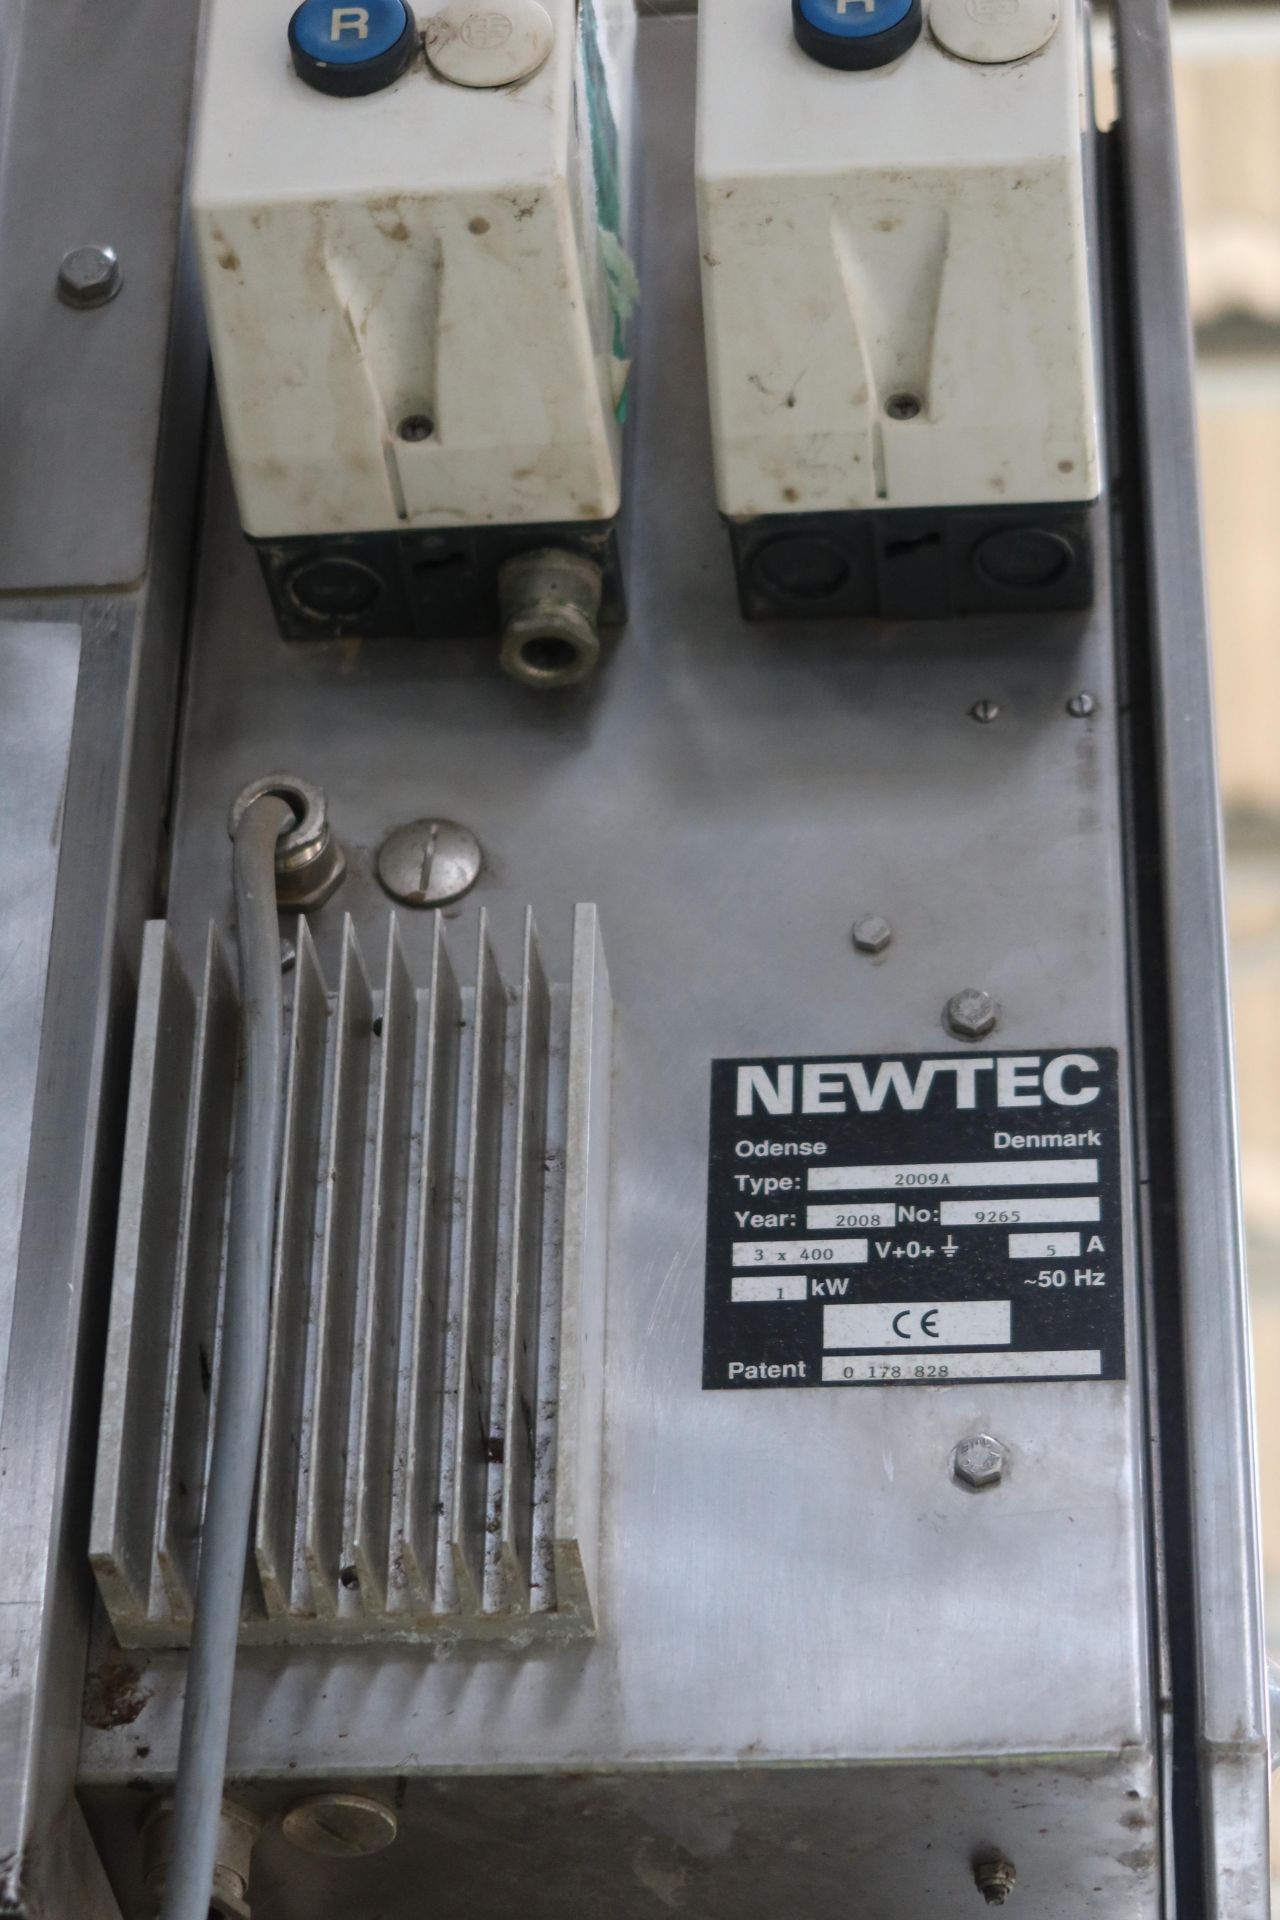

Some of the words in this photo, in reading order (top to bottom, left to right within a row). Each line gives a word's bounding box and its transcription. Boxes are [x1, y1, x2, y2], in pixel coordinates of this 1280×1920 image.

[331, 7, 369, 41] R
[736, 1054, 1100, 1116] NEWTEC
[735, 1139, 828, 1158] Odense
[994, 1129, 1102, 1150] Denmark
[734, 1173, 801, 1195] Type:
[895, 1172, 951, 1186] 2009A
[734, 1210, 797, 1228] Year:
[836, 1213, 881, 1227] 2008
[899, 1205, 939, 1223] No:
[975, 1210, 1021, 1223] 9265
[754, 1248, 764, 1262] 3
[777, 1251, 787, 1262] x
[800, 1247, 834, 1261] 400
[1046, 1243, 1056, 1257] 5
[1086, 1234, 1105, 1253] A
[1074, 1269, 1106, 1287] Hz
[775, 1287, 785, 1301] 1
[811, 1277, 850, 1296] kW
[728, 1360, 807, 1380] Patent
[843, 1365, 854, 1379] 0
[868, 1364, 902, 1379] 178
[914, 1364, 949, 1378] 828
